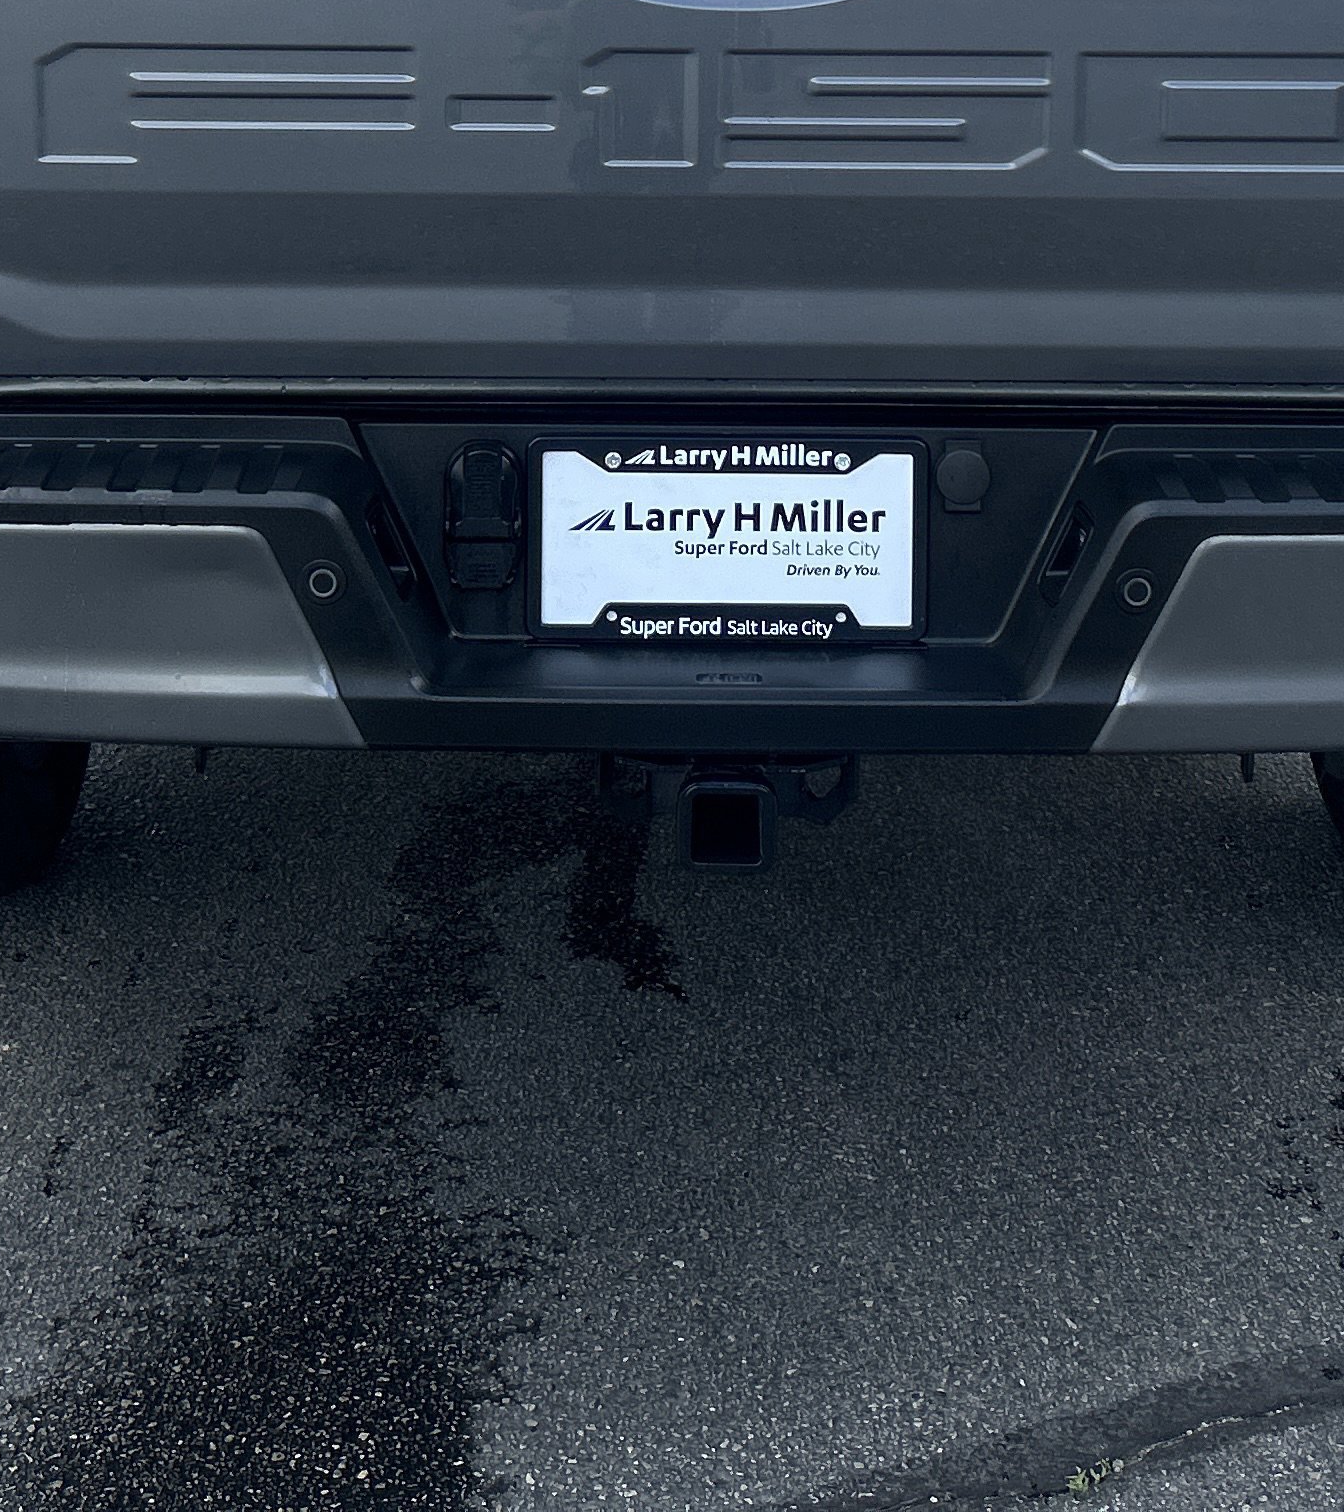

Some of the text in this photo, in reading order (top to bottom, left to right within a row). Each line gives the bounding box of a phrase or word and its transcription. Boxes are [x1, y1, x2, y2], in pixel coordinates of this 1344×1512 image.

[660, 445, 833, 470] Larry H Miller
[624, 499, 886, 538] Larry H Miller
[675, 540, 880, 560] Super Ford Salt Lake City
[787, 564, 830, 576] Driven
[834, 565, 851, 578] By
[620, 617, 833, 639] Super Ford Salt Lake City
